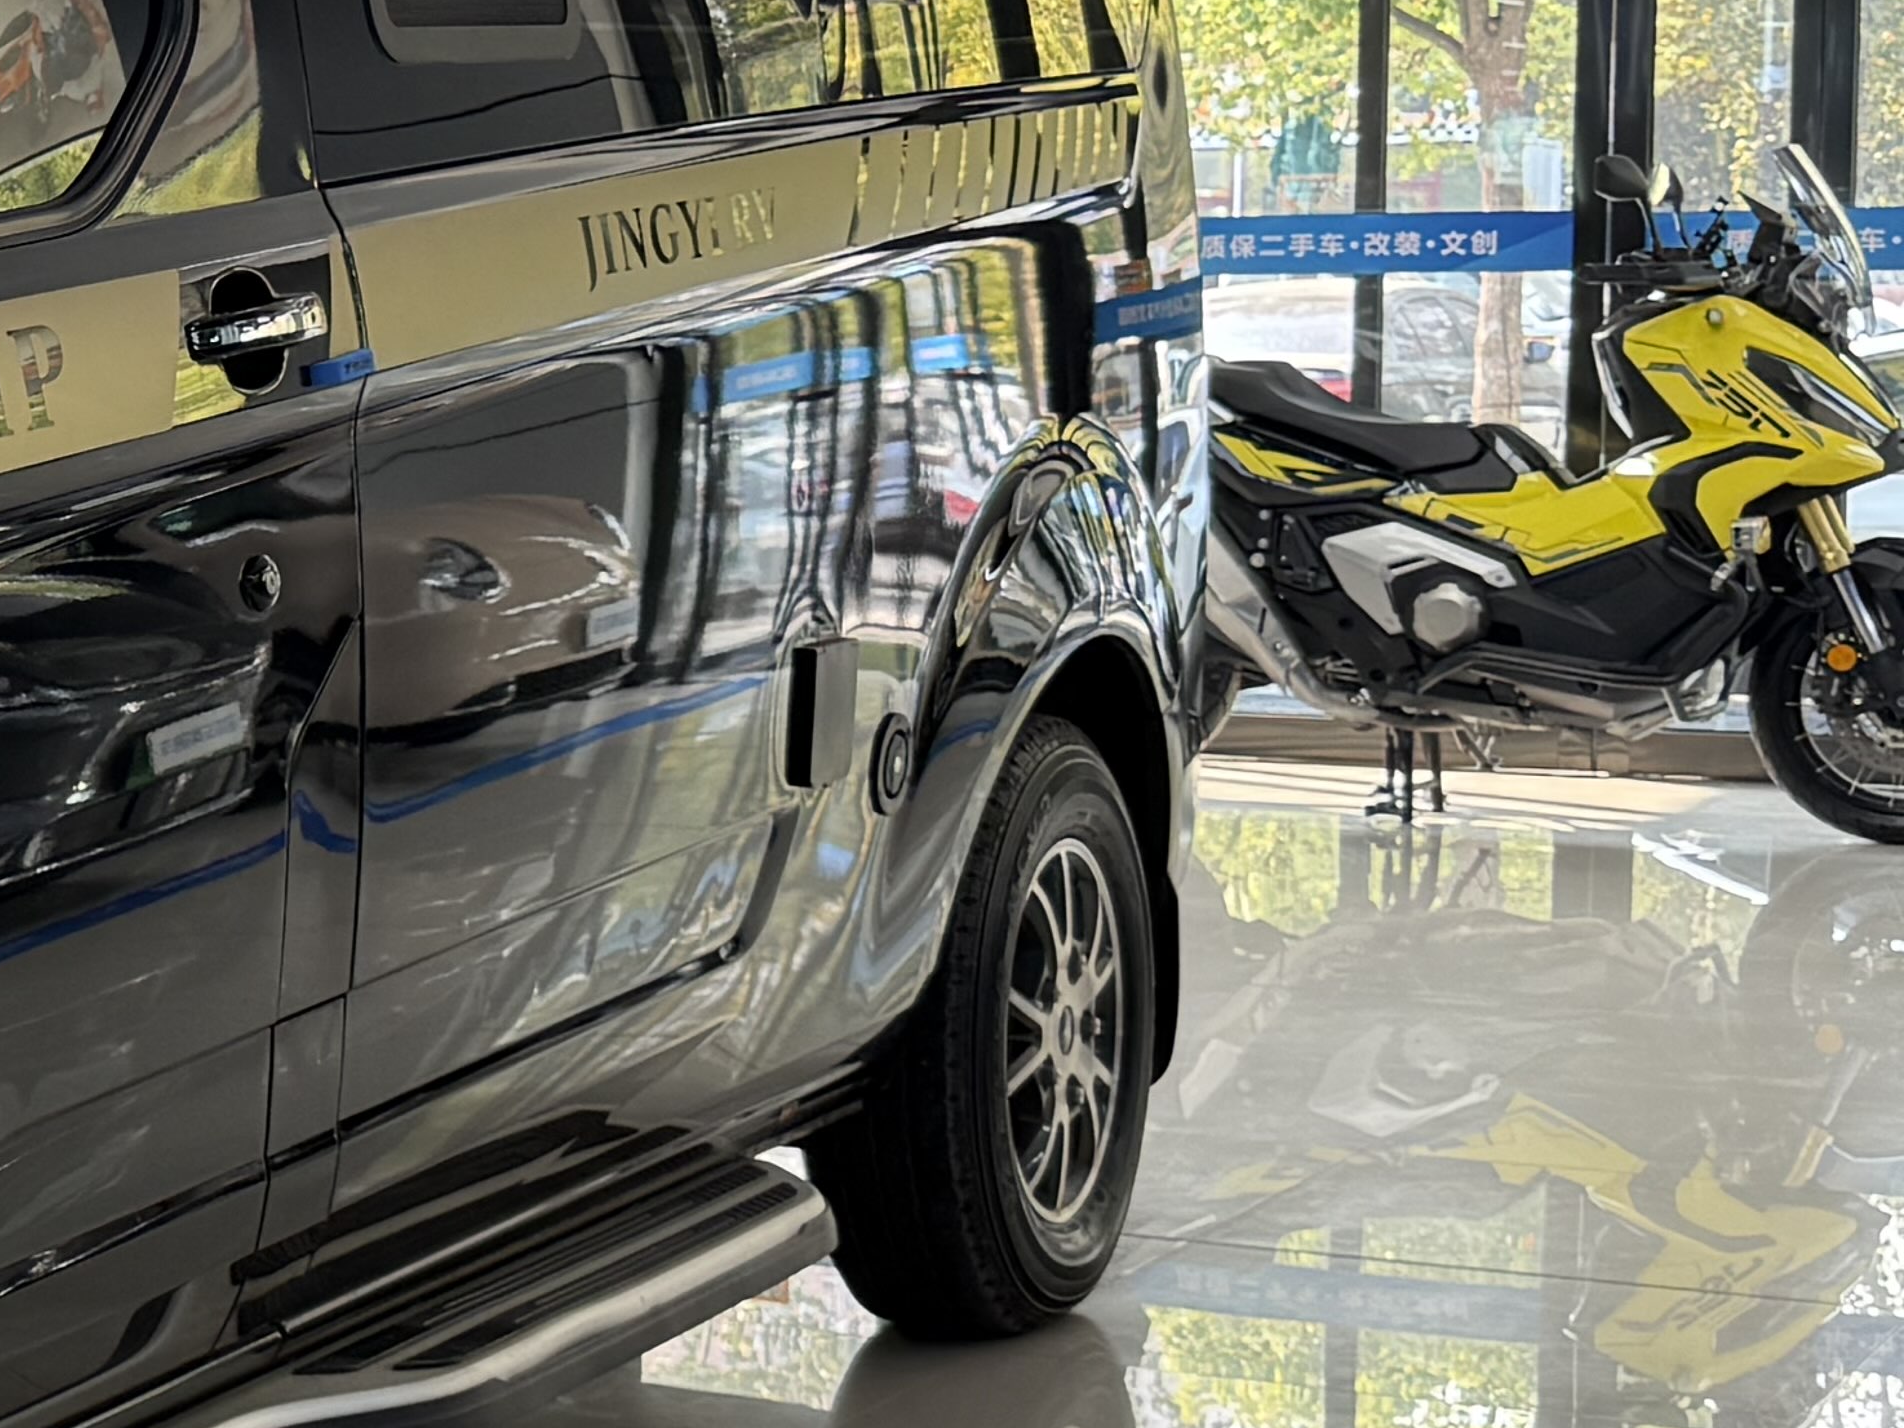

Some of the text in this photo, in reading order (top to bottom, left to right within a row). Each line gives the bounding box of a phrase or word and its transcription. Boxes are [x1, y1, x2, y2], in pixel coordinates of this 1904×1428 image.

[1200, 230, 1499, 260] 质保二手车·改装·文创
